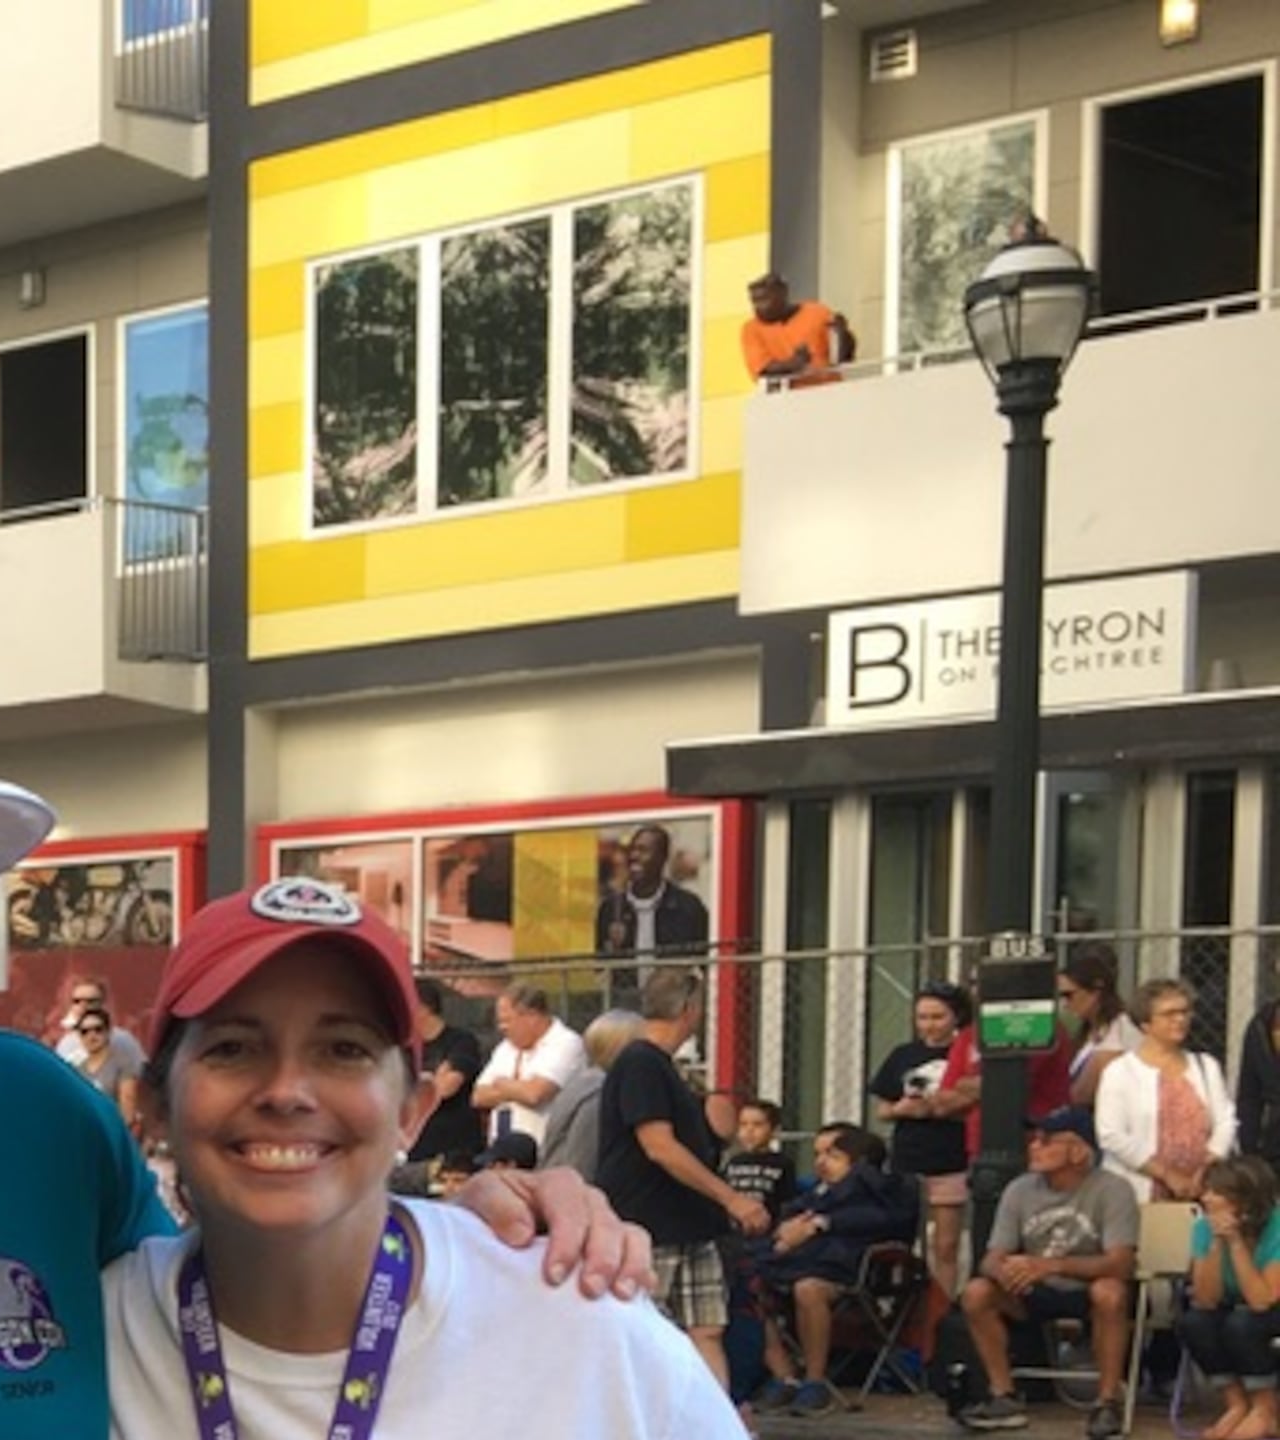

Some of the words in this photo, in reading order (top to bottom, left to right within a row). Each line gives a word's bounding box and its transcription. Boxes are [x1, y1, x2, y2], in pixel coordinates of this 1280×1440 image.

[938, 625, 1003, 660] THE
[1046, 607, 1165, 648] YRON
[849, 622, 913, 709] B
[939, 667, 977, 686] ON
[989, 936, 1046, 959] BUS
